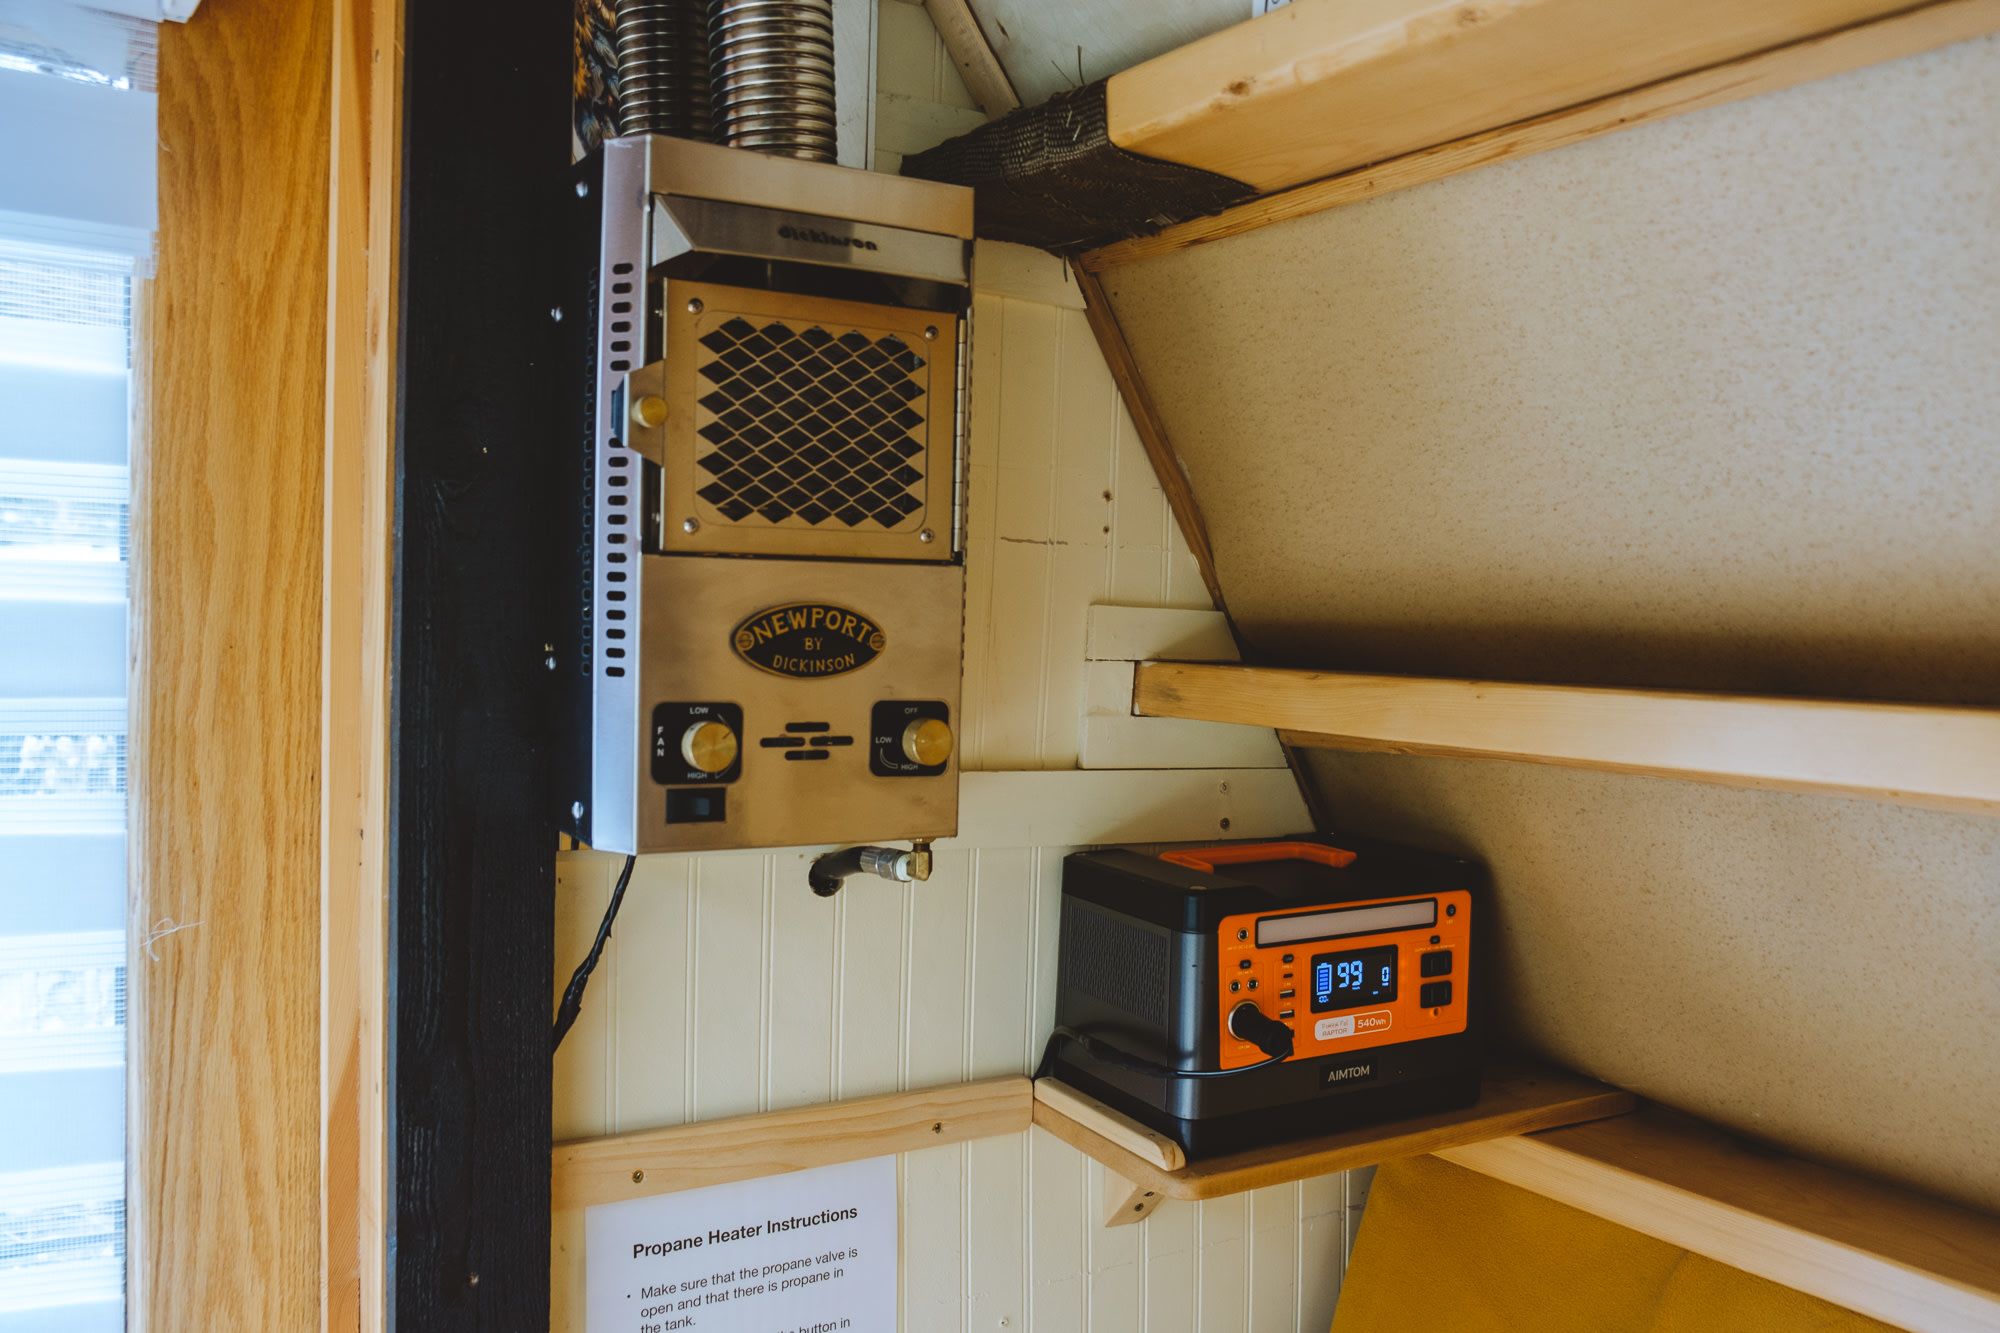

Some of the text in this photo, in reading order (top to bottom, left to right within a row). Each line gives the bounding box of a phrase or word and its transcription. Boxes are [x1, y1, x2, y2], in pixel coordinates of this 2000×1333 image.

[752, 608, 873, 645] NEWPORT
[804, 637, 824, 651] BY
[772, 653, 856, 673] DICKINSON
[689, 707, 709, 715] LOW
[875, 736, 893, 744] LOW
[687, 771, 708, 779] HIGH
[900, 763, 919, 771] HIGH
[1337, 960, 1363, 988] 99
[1322, 1027, 1348, 1037] RAPTOR
[1327, 1064, 1370, 1082] AIMTOM
[633, 1207, 858, 1259] Propane Heater Instructions
[641, 1247, 858, 1300] Make sure that the propane valve is
[640, 1266, 844, 1319] open and that there is propane in
[640, 1315, 696, 1333] the tank.
[799, 1317, 851, 1333] button in
